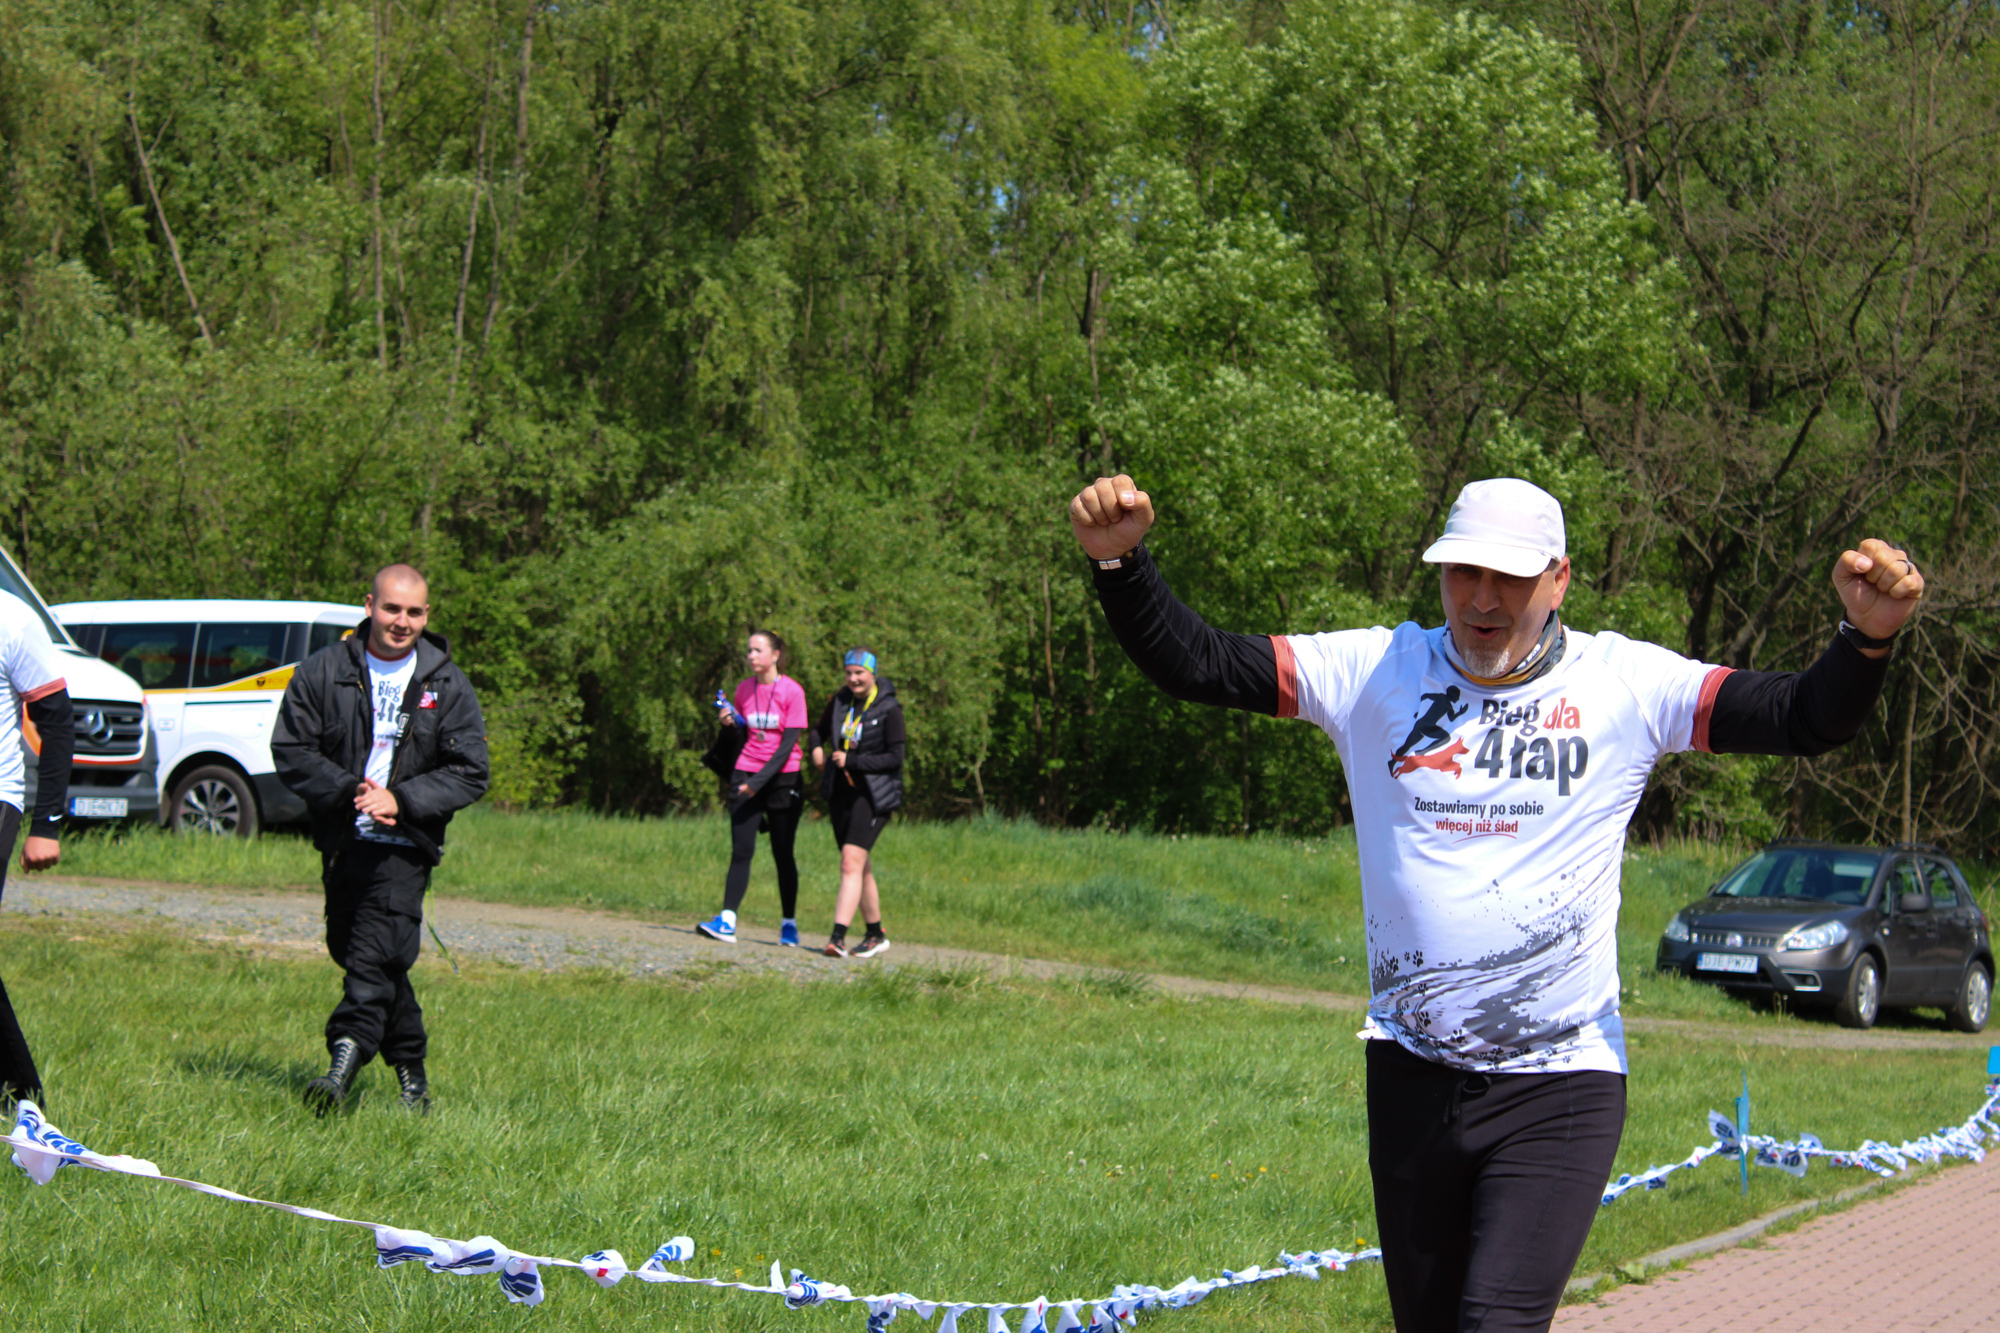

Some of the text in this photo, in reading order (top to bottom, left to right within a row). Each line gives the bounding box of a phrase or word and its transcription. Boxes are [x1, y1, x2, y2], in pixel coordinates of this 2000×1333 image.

[378, 680, 402, 702] Bieg
[1478, 697, 1581, 737] Bieg dla
[1414, 796, 1544, 819] Zostawiamy po sobie
[1435, 817, 1519, 836] więcej niż ślad
